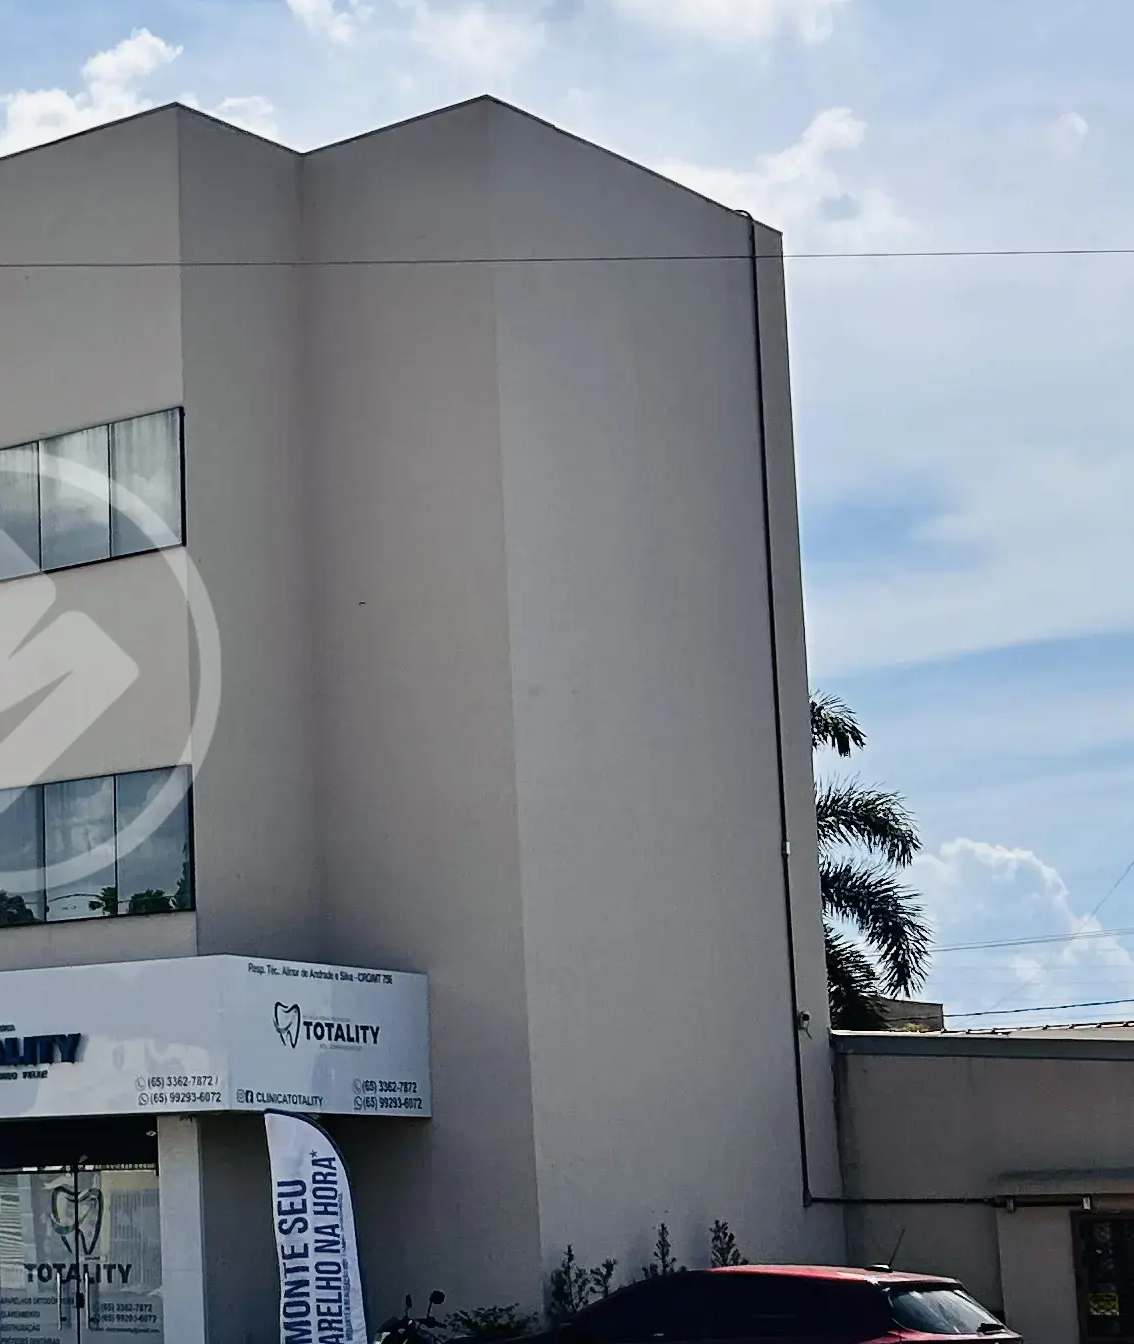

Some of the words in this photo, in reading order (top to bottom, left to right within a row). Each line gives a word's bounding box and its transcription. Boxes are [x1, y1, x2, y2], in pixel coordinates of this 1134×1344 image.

[303, 1021, 380, 1044] TOTALITY
[147, 1076, 164, 1089] (65)
[166, 1076, 213, 1088] 3362-7872
[362, 1080, 377, 1094] (65)
[379, 1080, 417, 1094] 3362-7872
[150, 1093, 167, 1104] (65)
[170, 1092, 222, 1103] 99293-6072
[256, 1092, 323, 1106] CLINICATOTALITY
[363, 1097, 378, 1111] (65)
[379, 1097, 423, 1110] 99293-6072
[277, 1179, 309, 1234] SEU
[314, 1224, 340, 1254] NA
[23, 1263, 132, 1284] TOTALITY
[281, 1243, 313, 1344] MONTE
